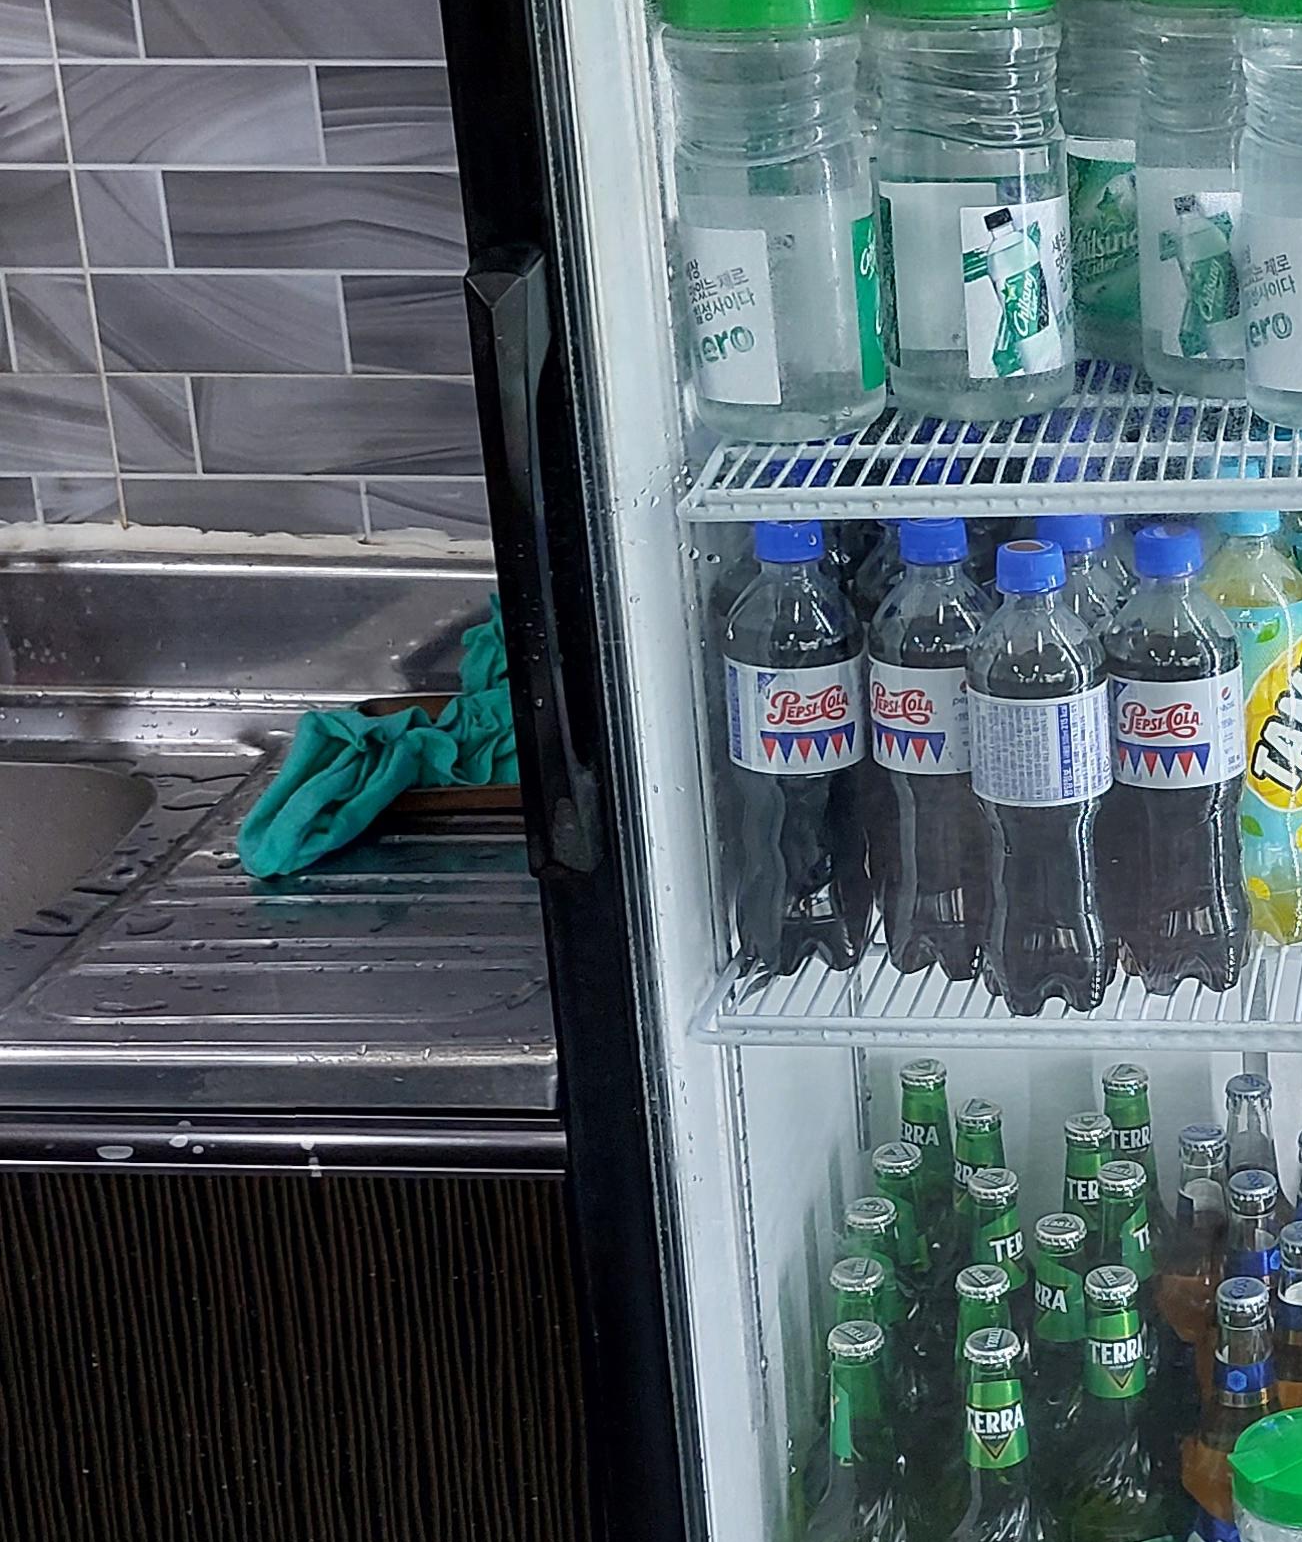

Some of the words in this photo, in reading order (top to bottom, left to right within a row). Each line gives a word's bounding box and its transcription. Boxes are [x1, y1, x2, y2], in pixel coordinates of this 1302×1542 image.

[695, 325, 755, 367] ero
[900, 1121, 940, 1147] RRA
[1110, 1125, 1152, 1151] TERR
[1066, 1176, 1101, 1201] TER
[988, 1230, 1024, 1263] TER
[966, 1402, 1025, 1435] TERRA
